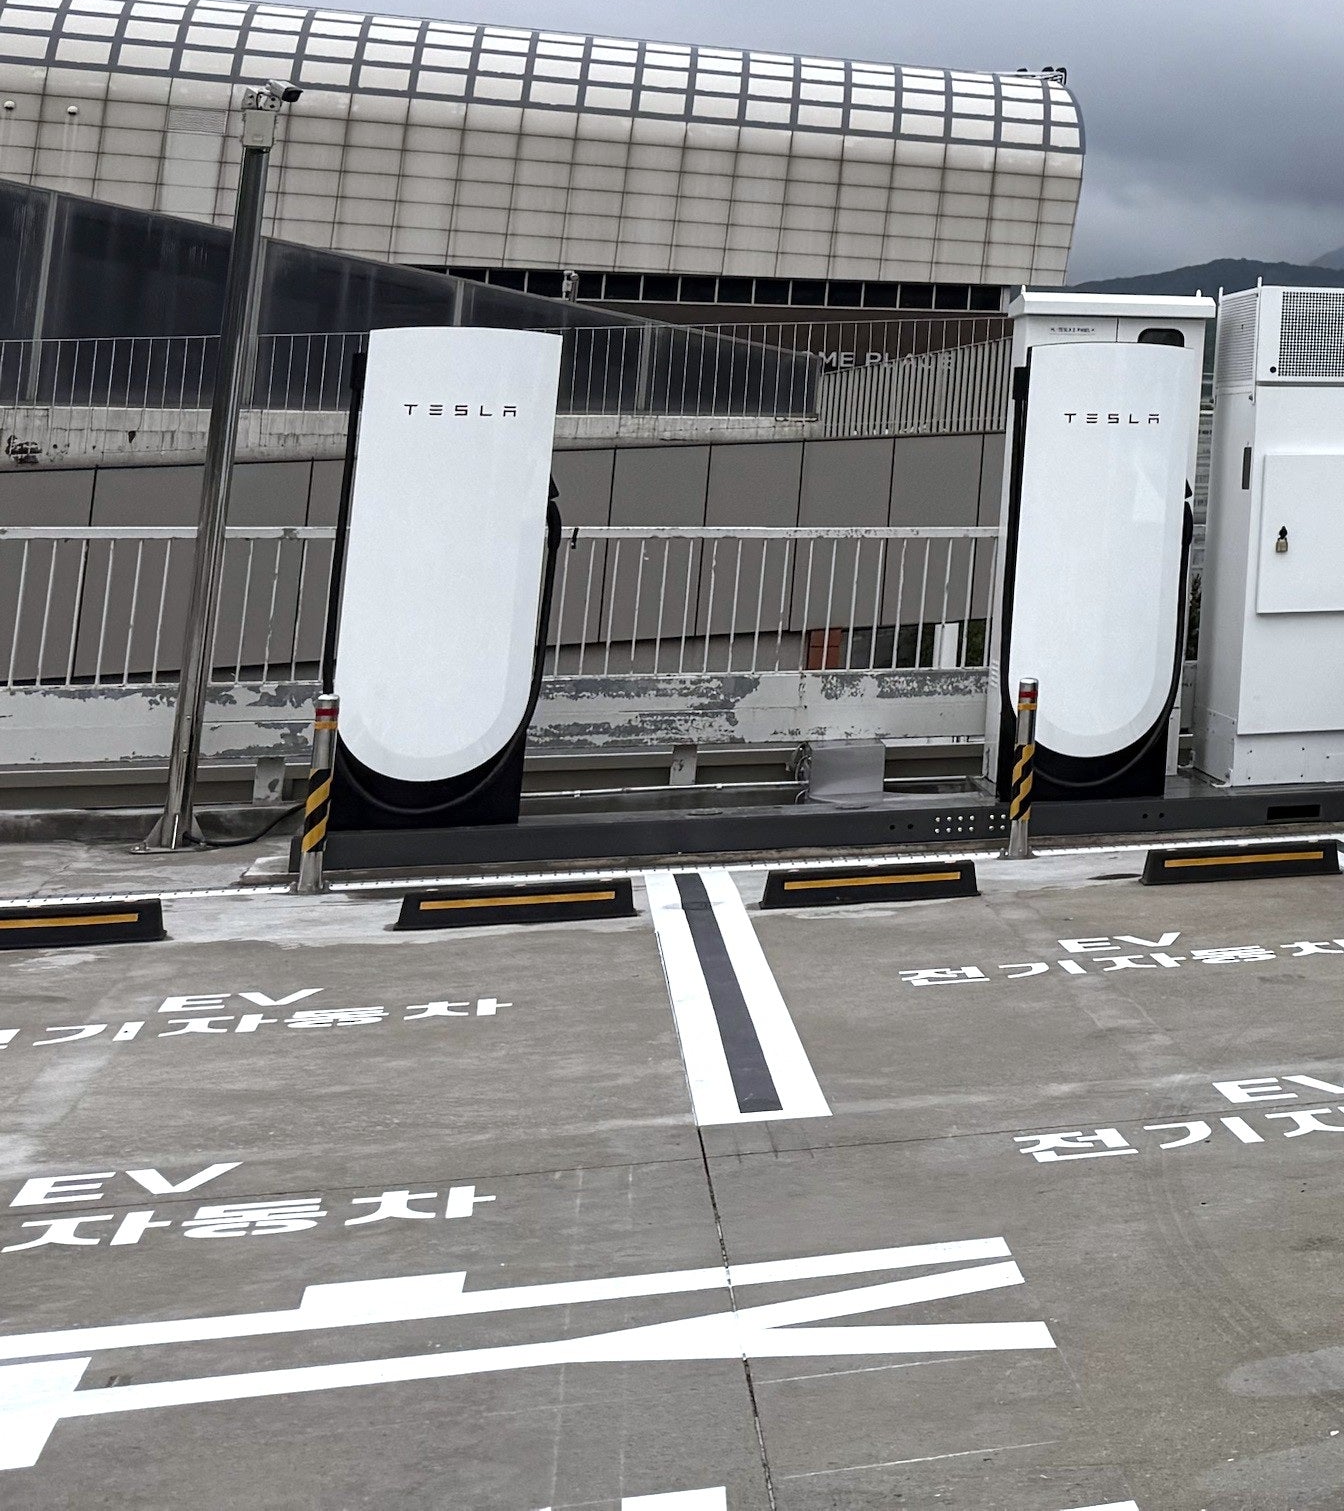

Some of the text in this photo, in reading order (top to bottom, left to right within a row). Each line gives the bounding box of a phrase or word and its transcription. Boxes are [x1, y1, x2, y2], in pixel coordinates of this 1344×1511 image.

[403, 403, 517, 418] TESLA
[1063, 412, 1160, 425] TESLA
[1058, 931, 1182, 953] EV
[157, 988, 325, 1013] EV
[9, 1161, 244, 1208] EV
[0, 1185, 497, 1254] 자동차
